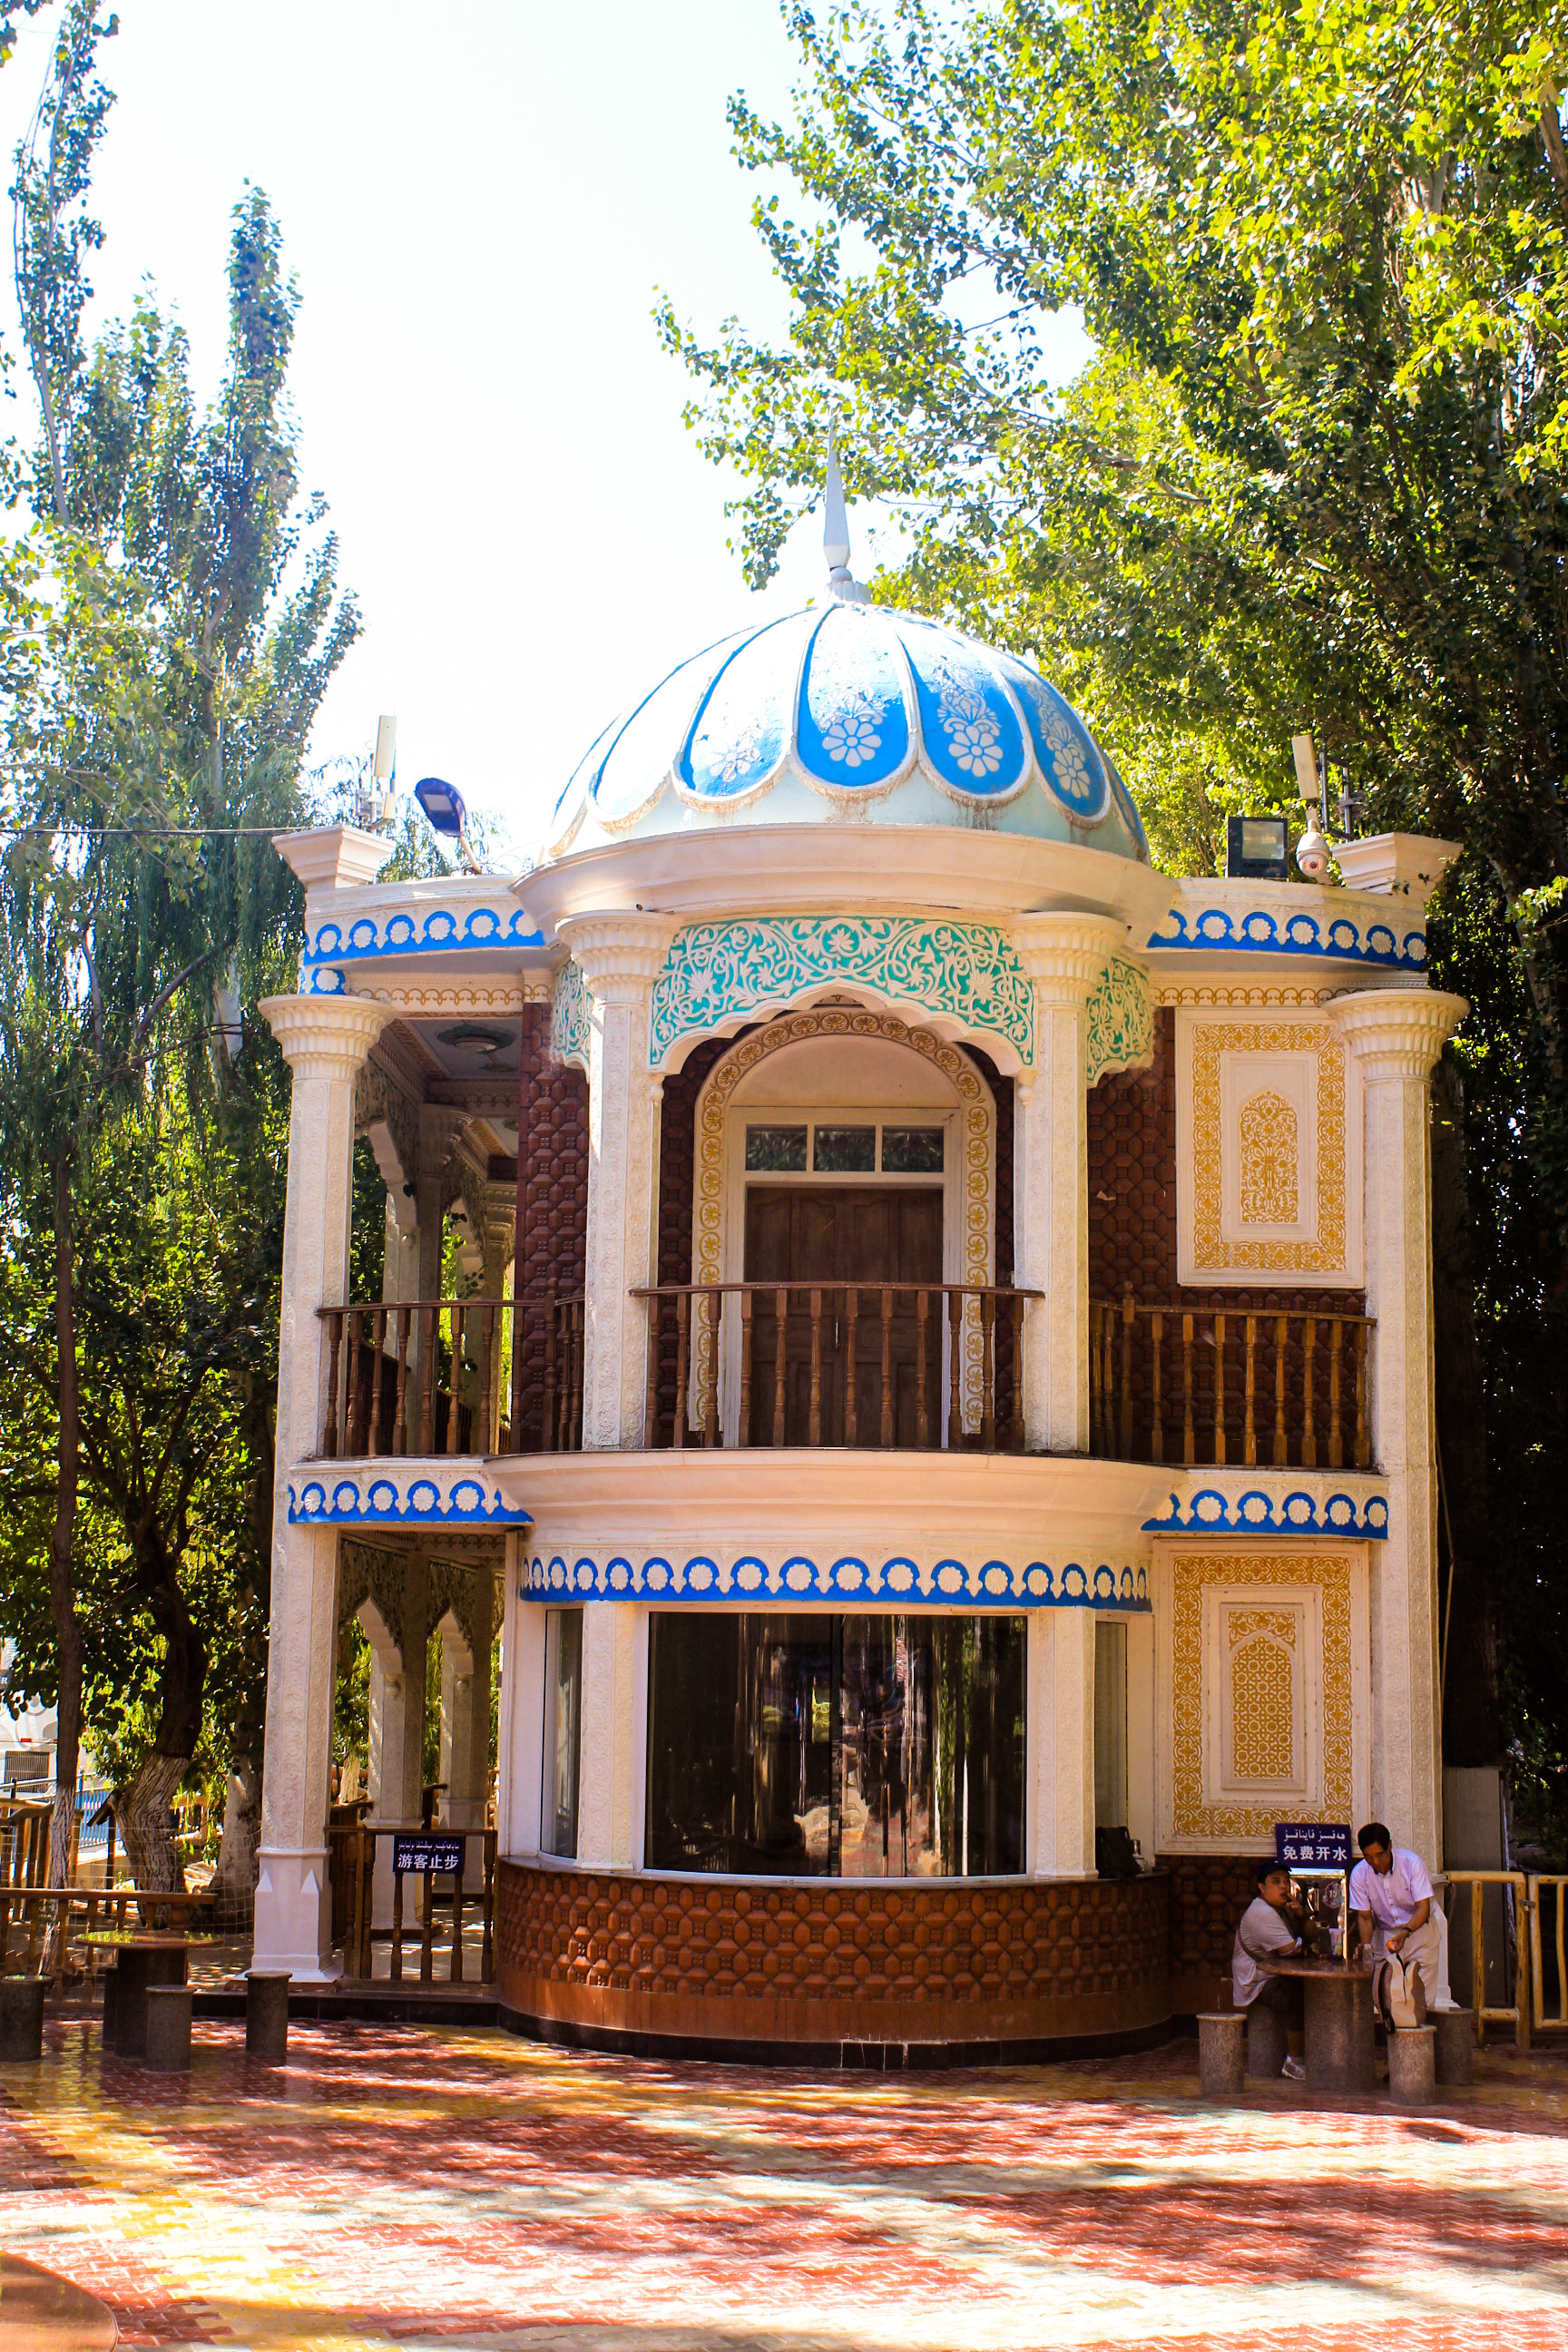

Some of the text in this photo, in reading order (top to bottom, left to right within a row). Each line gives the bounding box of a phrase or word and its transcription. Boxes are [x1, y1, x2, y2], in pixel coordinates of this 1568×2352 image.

[1282, 1846, 1348, 1861] 免费开水
[397, 1854, 459, 1869] 游客止步
